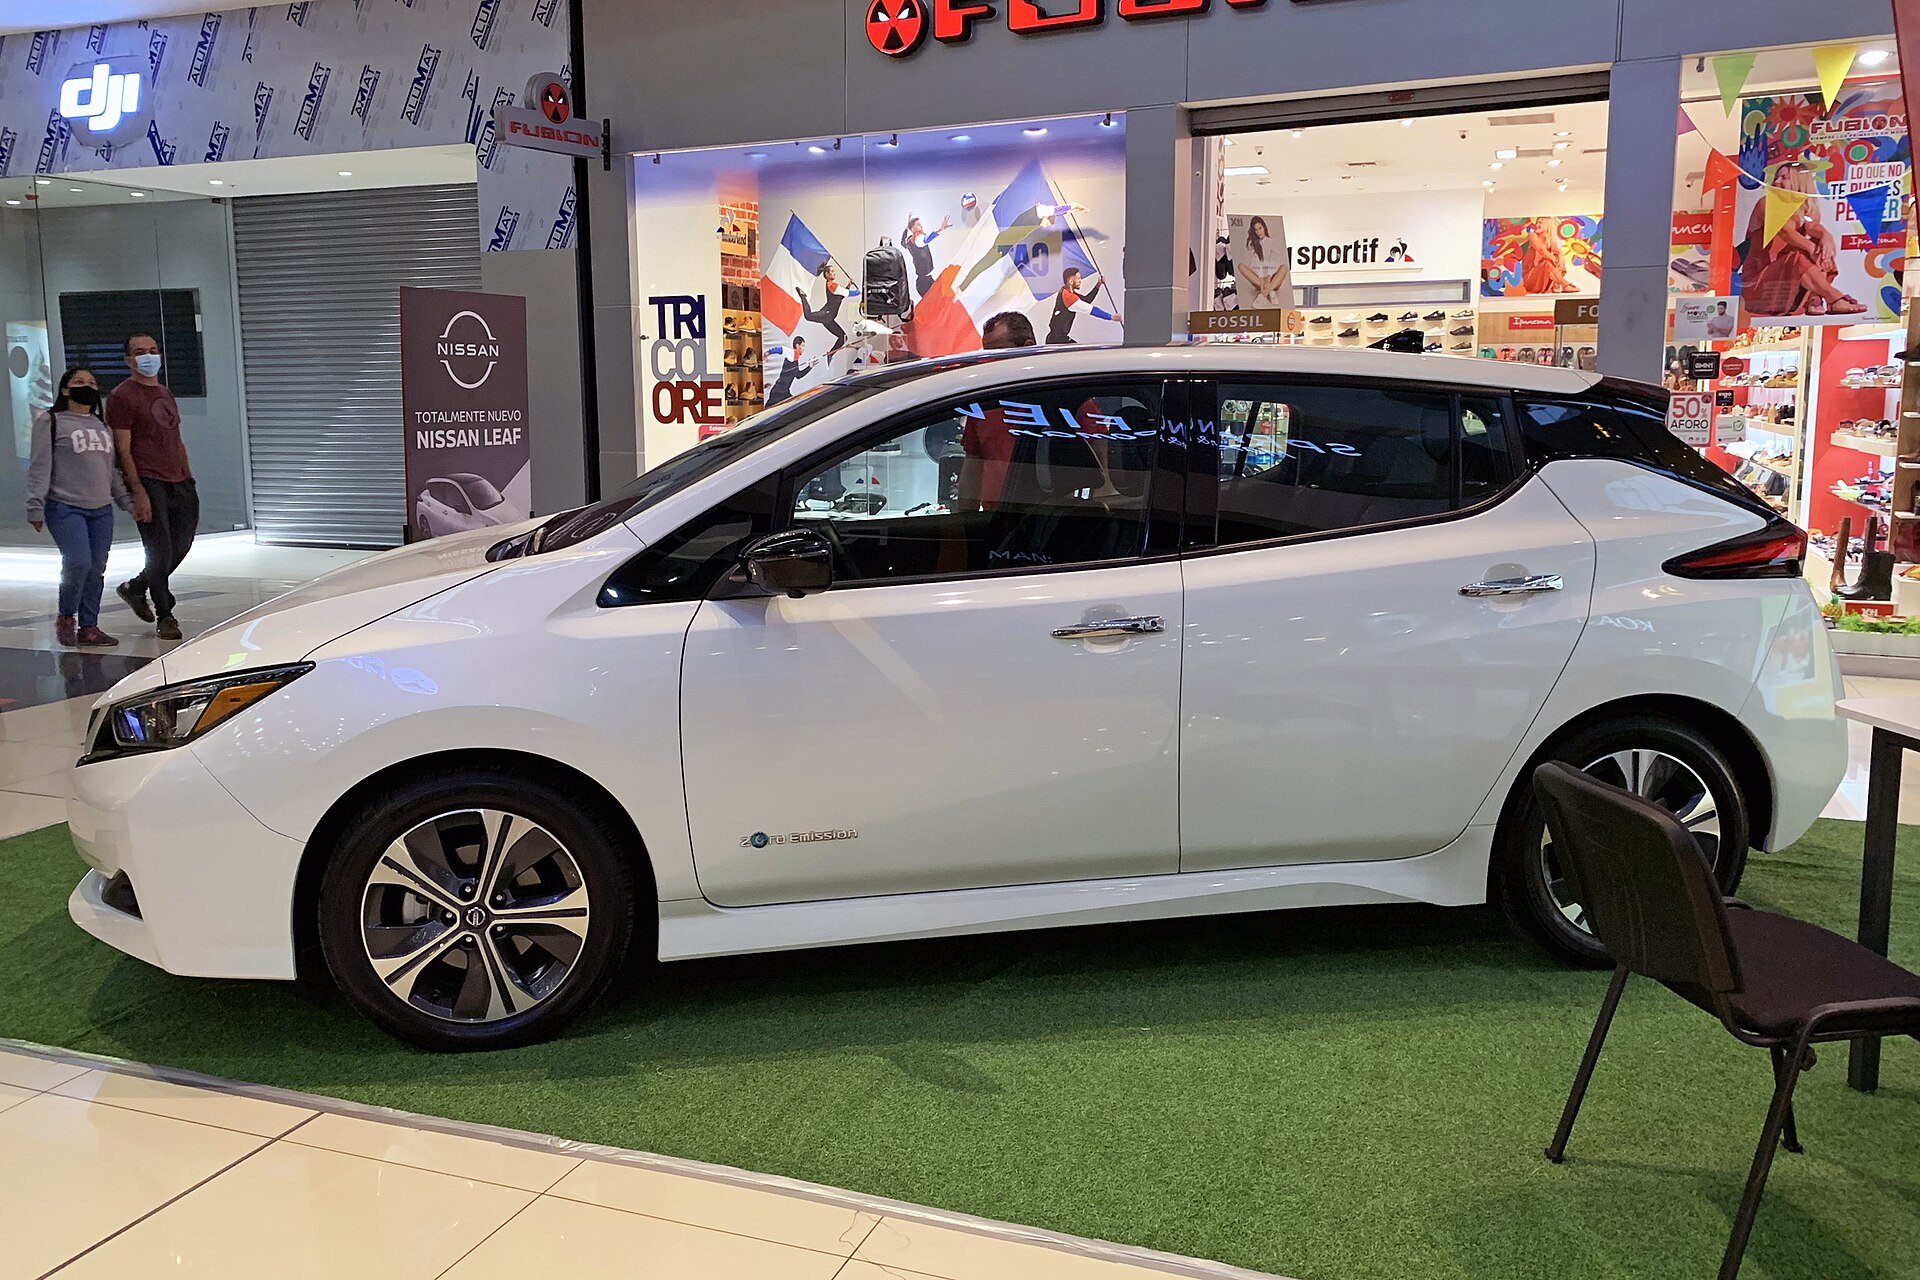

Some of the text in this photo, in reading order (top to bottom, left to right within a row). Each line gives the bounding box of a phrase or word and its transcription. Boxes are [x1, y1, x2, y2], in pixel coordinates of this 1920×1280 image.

[192, 13, 216, 85] ALUMAT
[405, 43, 436, 121] ALUMAT
[298, 62, 326, 138] ALUMAT
[509, 121, 599, 148] FUSION
[1851, 164, 1902, 179] LO QUE NO
[1830, 184, 1846, 200] TE
[1297, 238, 1379, 270] sportif
[648, 294, 707, 340] TRI
[1208, 315, 1263, 328] FOSSIL
[1512, 316, 1552, 328] Ipanema
[437, 342, 500, 357] NISSAN
[651, 338, 724, 382] COL
[652, 380, 726, 425] ORE
[415, 410, 521, 424] TOTALMENTE NUEVO
[1670, 419, 1709, 429] AFORO
[416, 427, 521, 449] NISSAN LEAF
[789, 829, 858, 843] Emission
